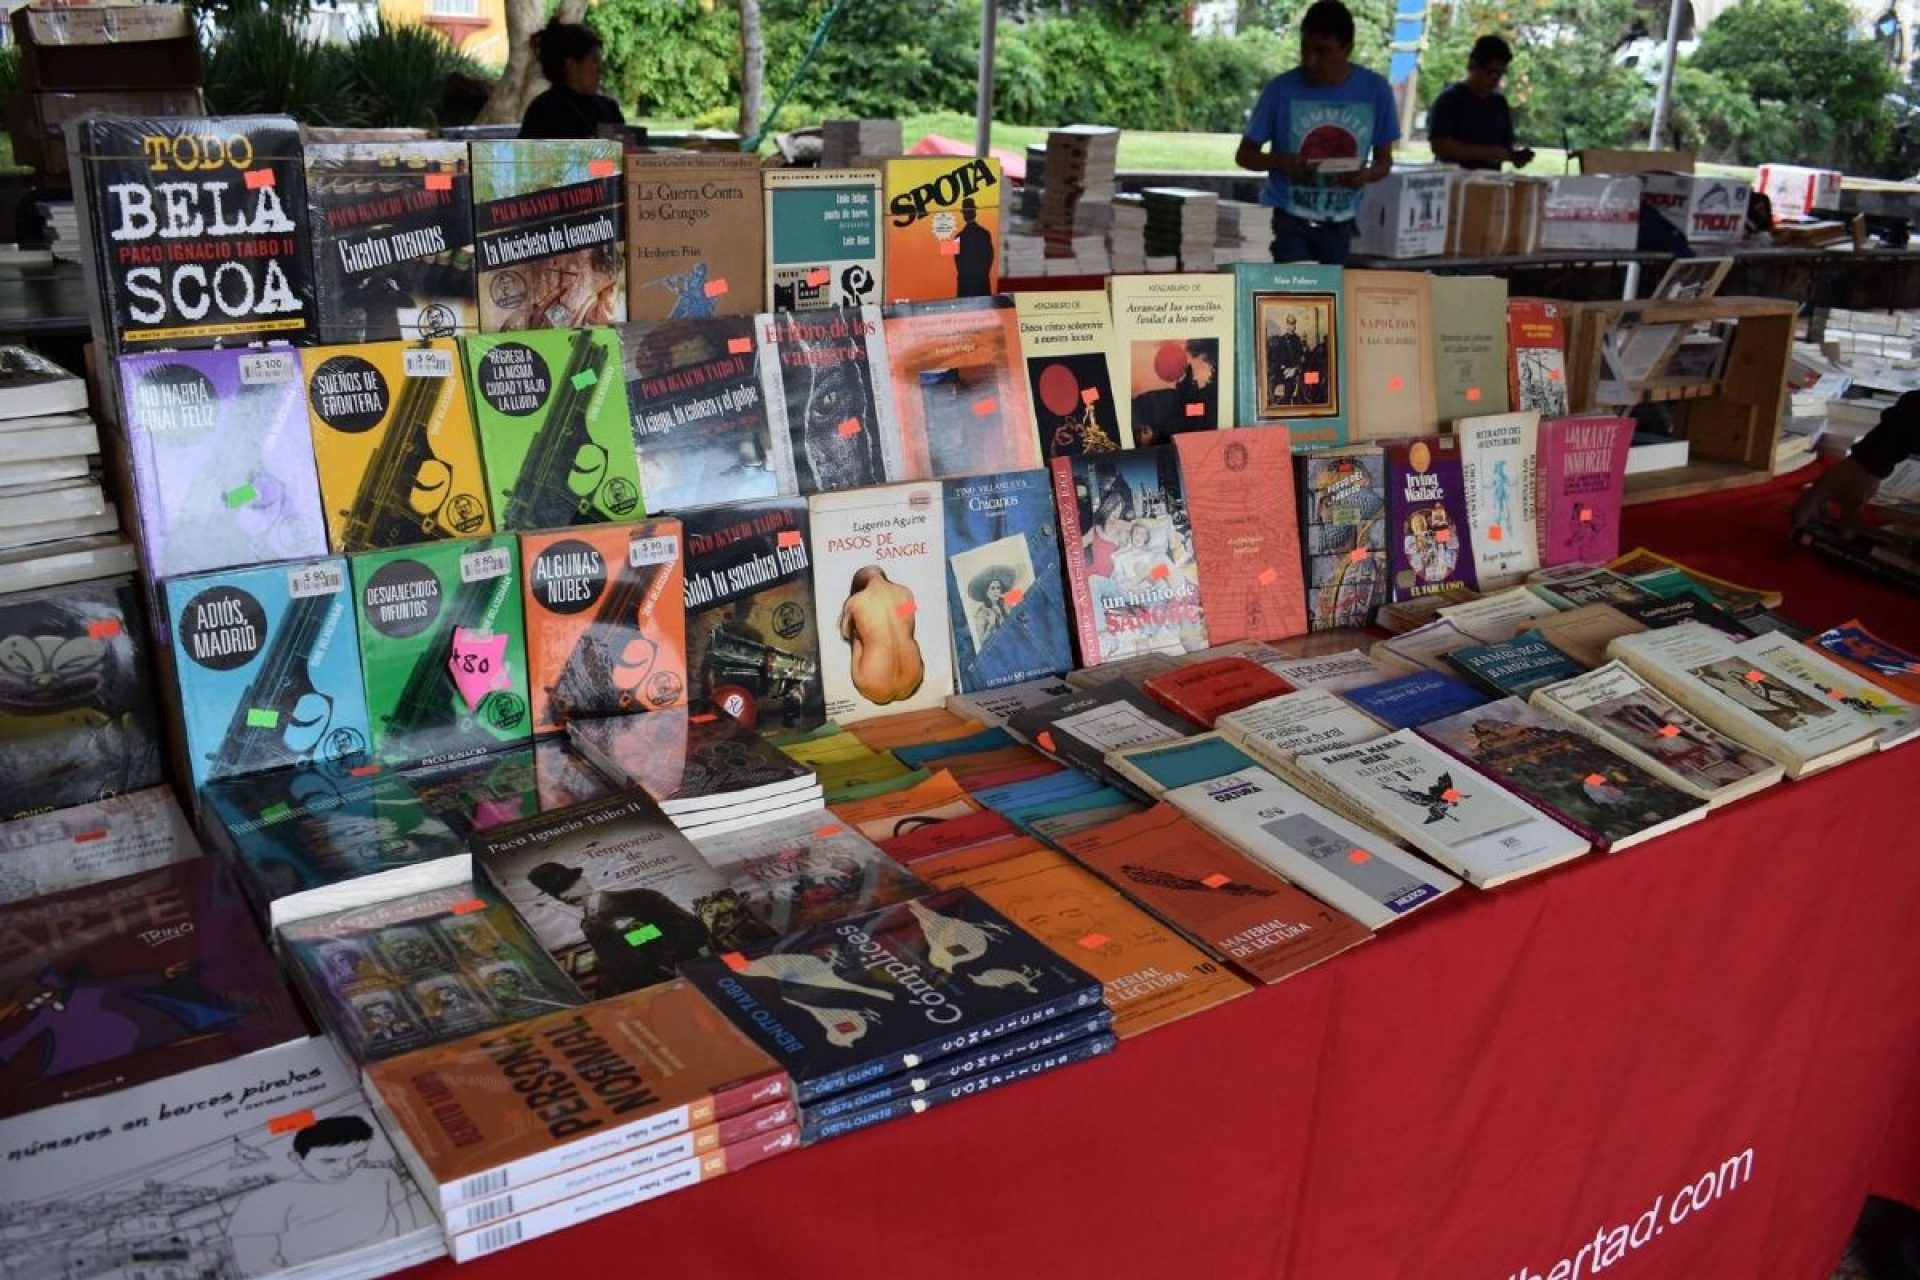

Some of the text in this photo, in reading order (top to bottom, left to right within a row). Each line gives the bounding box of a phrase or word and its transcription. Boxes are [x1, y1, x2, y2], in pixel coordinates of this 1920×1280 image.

[143, 134, 254, 171] TODO
[638, 183, 743, 201] La Guerra Contra
[890, 158, 998, 228] SPOTA
[107, 182, 296, 240] BELA
[638, 203, 711, 226] los Gringos
[1693, 212, 1741, 231] TROUT
[119, 239, 294, 264] PACO IGNACIO TAIBO II
[338, 225, 446, 274] Cuatro manos
[498, 231, 550, 264] bicicleta
[548, 225, 565, 252] de
[125, 259, 304, 324] SCOA
[1126, 302, 1184, 314] Arrancad las
[1175, 313, 1189, 324] los
[765, 323, 784, 345] El
[830, 318, 849, 337] de
[852, 318, 876, 337] los
[265, 358, 282, 370] 100
[317, 370, 380, 396] SUEÑOS DE
[322, 391, 384, 418] FRONTERA
[1404, 485, 1445, 502] Wallace
[1406, 472, 1440, 490] Irving
[968, 494, 1019, 512] Chicanos
[852, 513, 928, 534] Eugenio Aguirre
[827, 531, 895, 554] PASOS DE
[875, 541, 930, 562] SANGRE
[536, 551, 600, 581] ALGUNAS
[367, 578, 439, 607] DESVANECIDOS
[547, 577, 592, 604] NUBES
[1176, 583, 1196, 598] de
[197, 596, 249, 630] ADIÓS,
[380, 599, 429, 623] DIFUNTOS
[192, 624, 258, 660] MADRID
[486, 801, 642, 855] Paco Ignacio Taibo II
[585, 831, 666, 861] Temporada
[626, 850, 644, 862] de
[614, 853, 679, 881] zopilotes
[137, 921, 195, 946] TRINO
[1218, 918, 1289, 952] MATERIAL
[1230, 921, 1313, 959] DE LECTURA
[836, 924, 964, 1024] Cómplices
[1103, 966, 1165, 994] ATERIAL
[1192, 962, 1217, 977] 10
[1117, 970, 1190, 1003] LECTURA
[716, 976, 804, 1053] BENITO TAIBO
[542, 1015, 660, 1115] NORMAL
[6, 1124, 113, 1163] números
[120, 1114, 151, 1132] en
[157, 1088, 235, 1123] barcos
[237, 1066, 325, 1105] piratas
